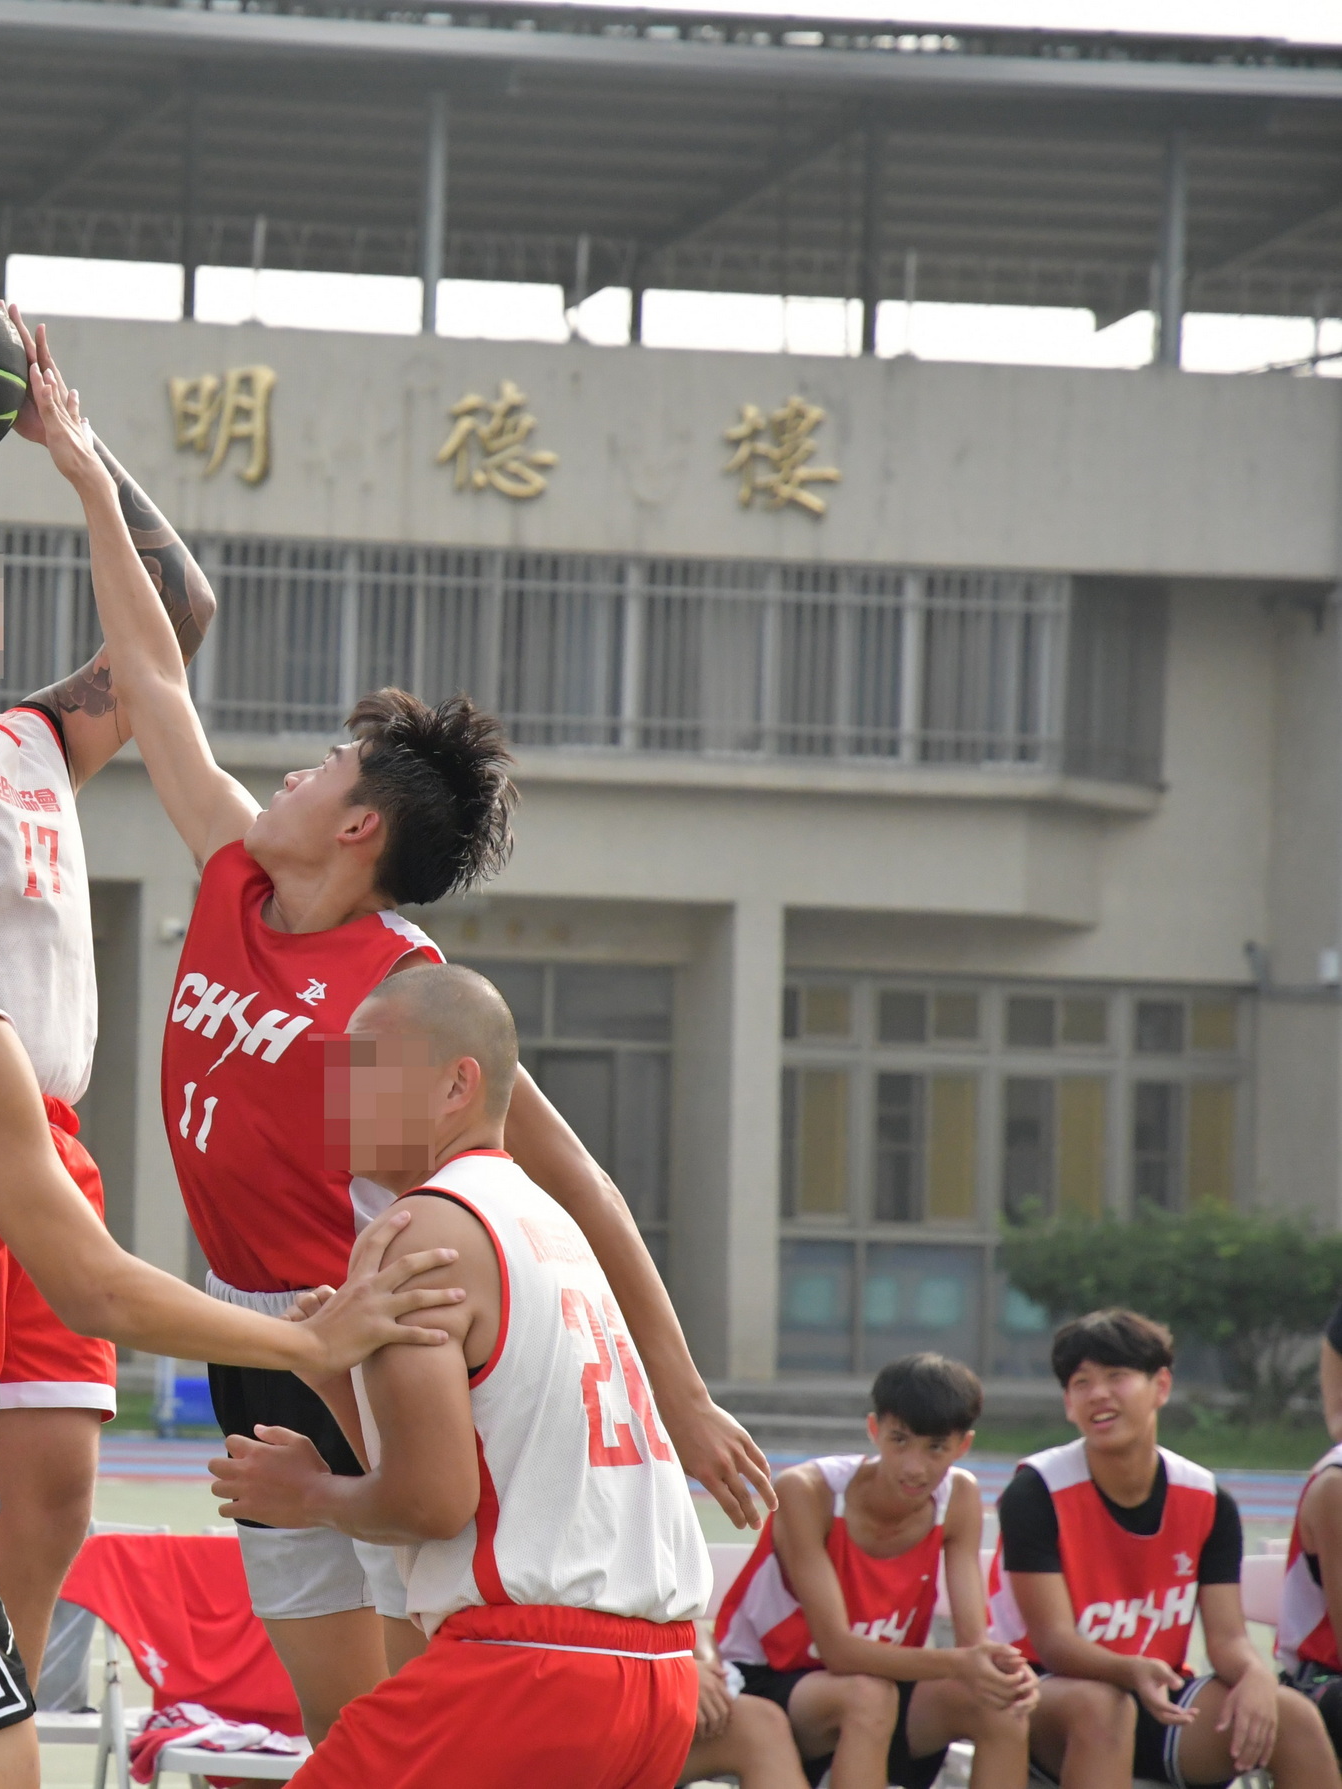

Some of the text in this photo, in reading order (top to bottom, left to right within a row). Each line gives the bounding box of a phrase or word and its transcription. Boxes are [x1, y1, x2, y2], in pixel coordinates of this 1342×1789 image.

[167, 363, 842, 518] 明德樓
[19, 821, 61, 898] 17
[171, 972, 314, 1077] CHSH
[179, 1081, 219, 1154] 11
[1076, 1581, 1198, 1656] CHSH
